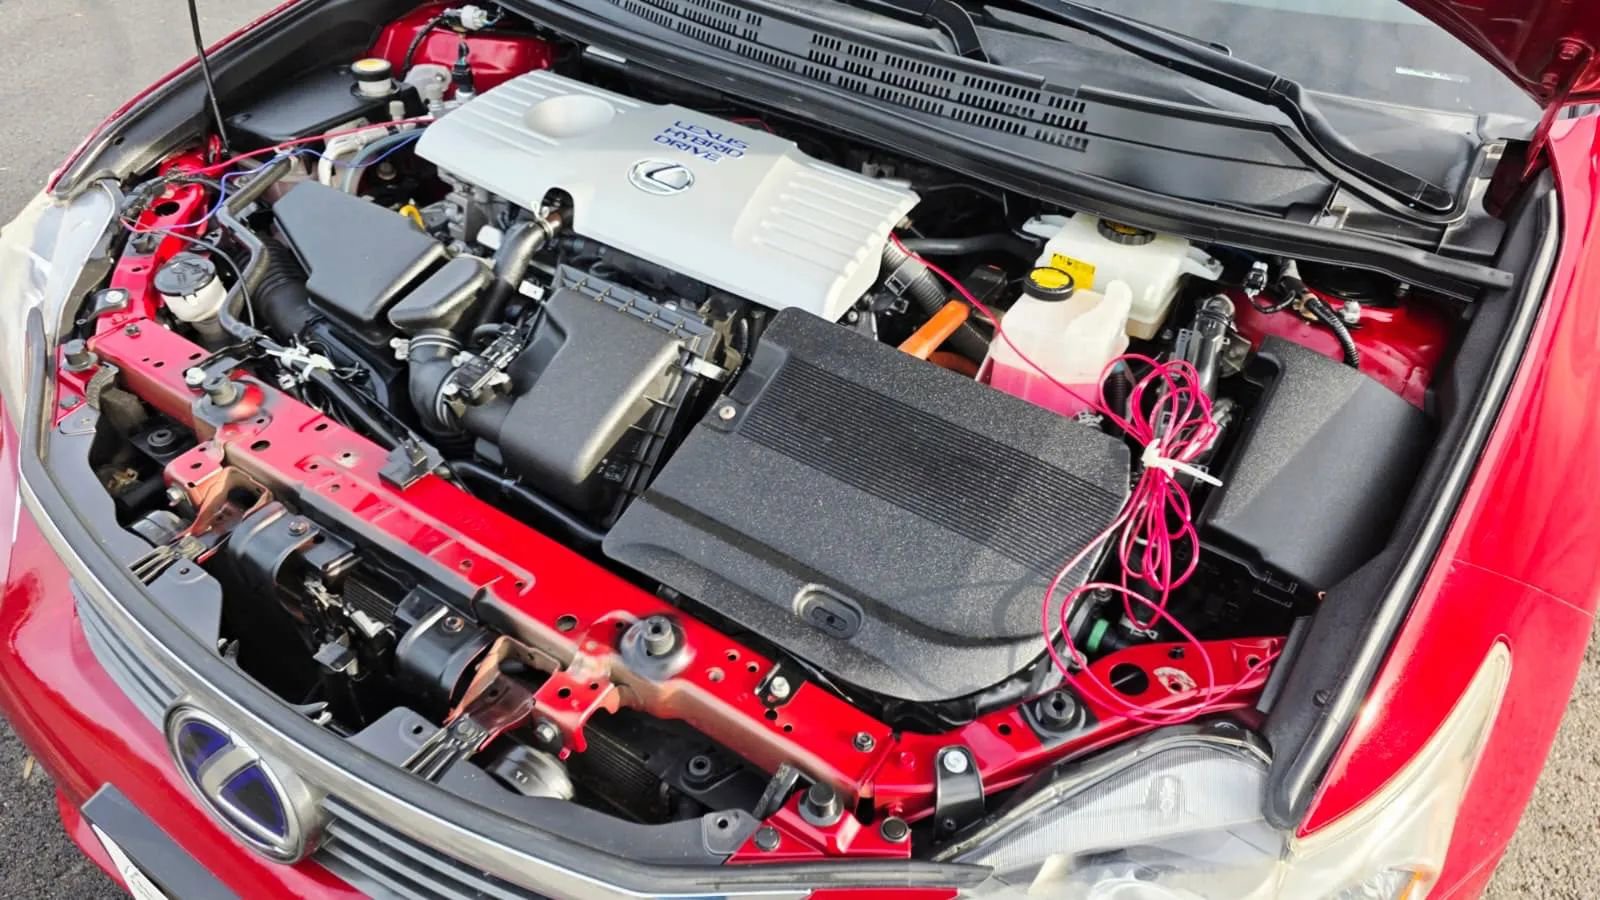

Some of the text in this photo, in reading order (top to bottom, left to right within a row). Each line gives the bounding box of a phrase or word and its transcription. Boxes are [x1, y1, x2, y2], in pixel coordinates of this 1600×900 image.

[653, 135, 723, 162] DRIVE
[664, 127, 745, 159] HYBRID
[674, 120, 750, 149] LEXUS
